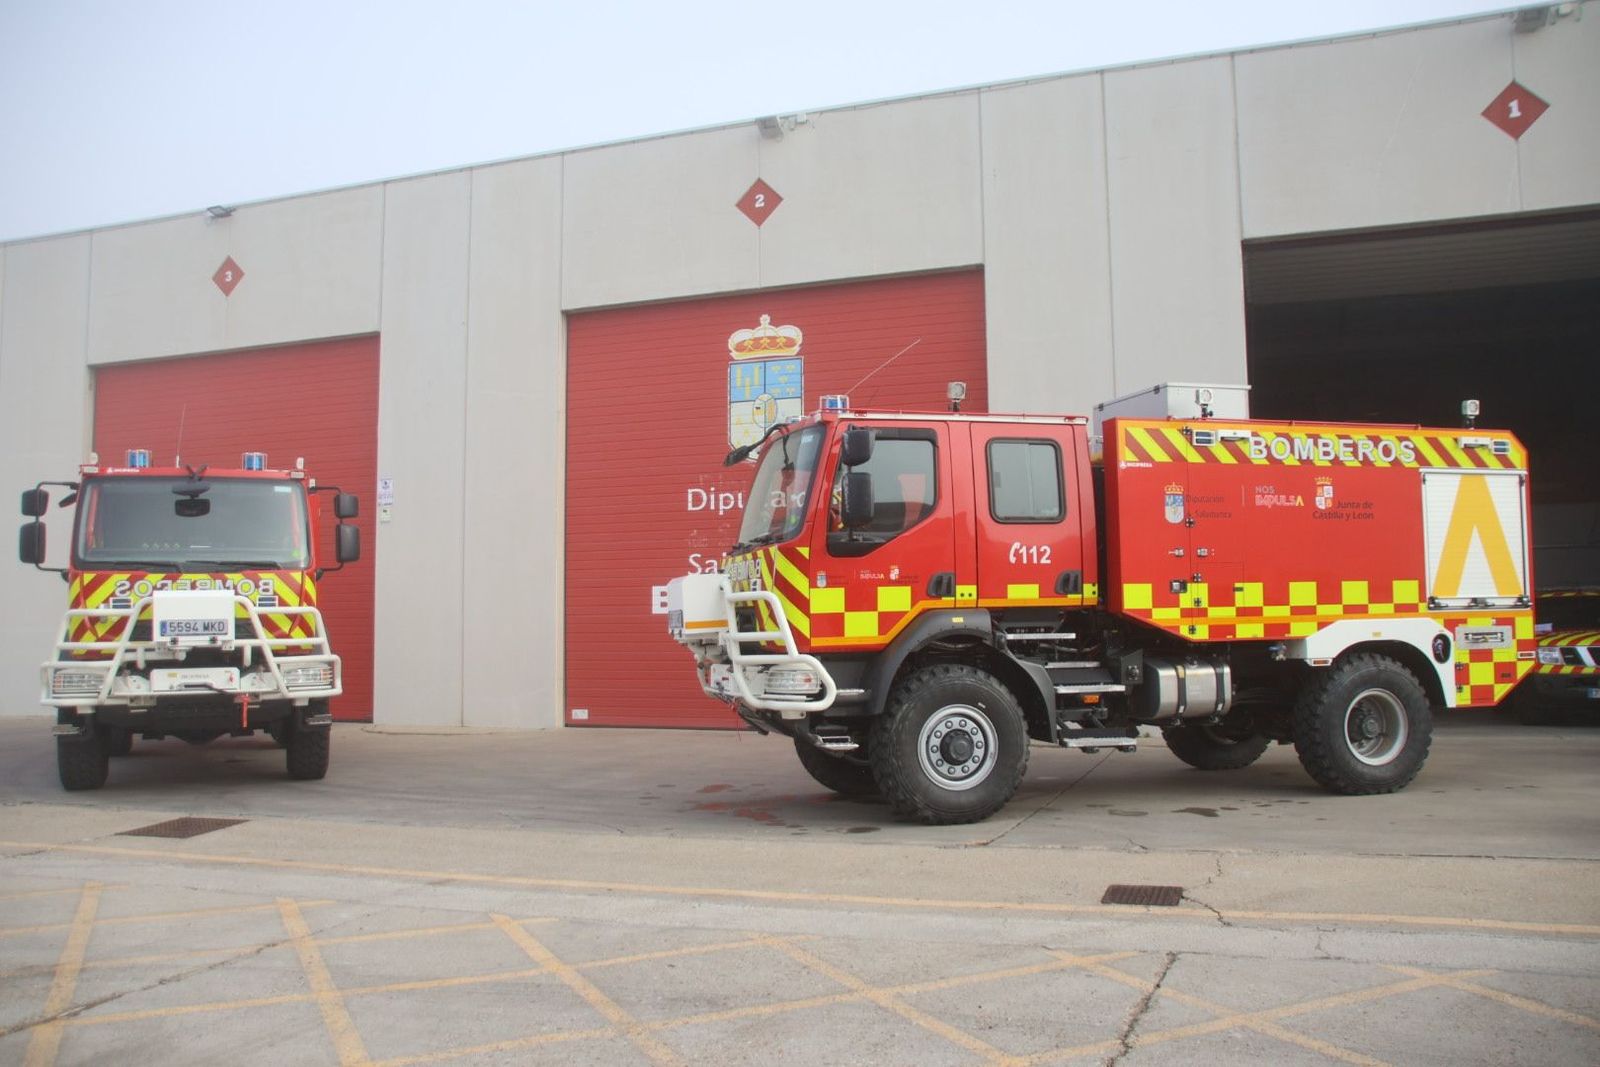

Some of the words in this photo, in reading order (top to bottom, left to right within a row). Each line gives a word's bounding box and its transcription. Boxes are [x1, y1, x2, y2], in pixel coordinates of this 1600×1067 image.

[1508, 99, 1522, 118] 1
[755, 193, 765, 208] 2
[224, 271, 233, 282] 3
[1249, 436, 1417, 463] BOMBEROS
[1255, 486, 1275, 494] NOS
[1019, 544, 1052, 565] 112
[169, 621, 199, 633] 5594
[203, 620, 226, 632] MKD
